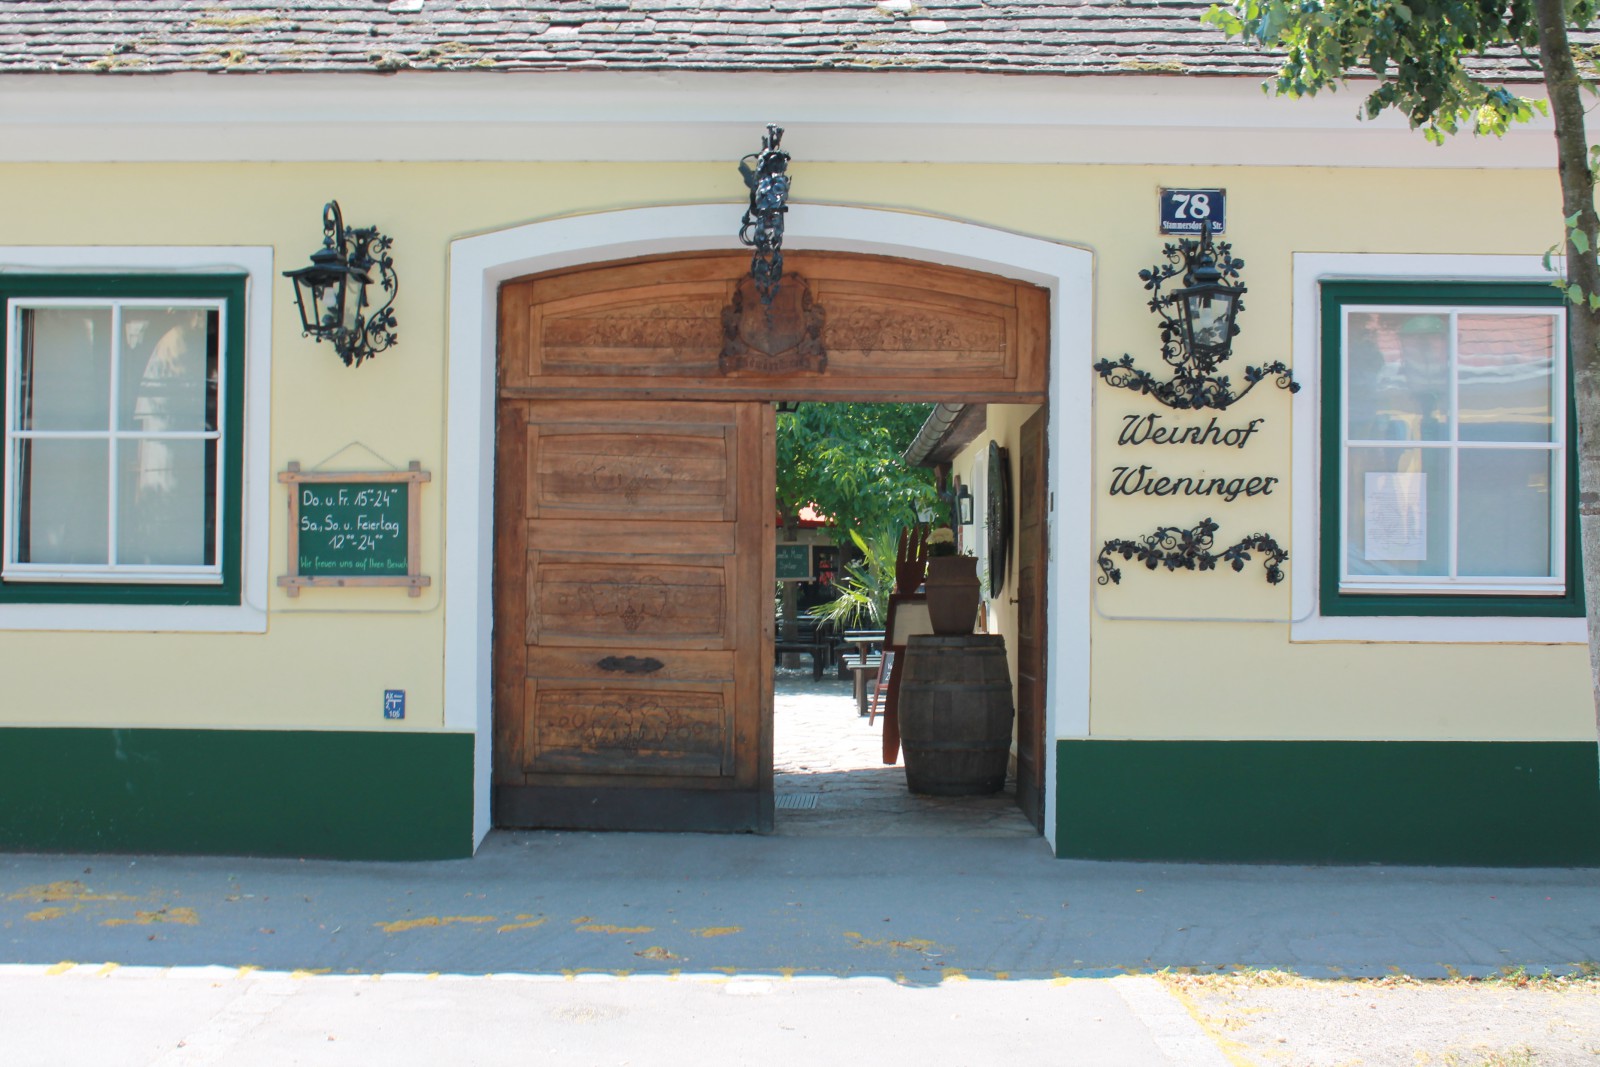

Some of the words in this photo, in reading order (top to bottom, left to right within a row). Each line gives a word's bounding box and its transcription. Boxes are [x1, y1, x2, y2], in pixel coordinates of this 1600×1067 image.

[1171, 193, 1210, 219] 78
[1117, 413, 1265, 449] Weinhof
[1109, 464, 1279, 502] Wieninger
[303, 489, 323, 506] Do.
[325, 497, 336, 506] u.
[338, 489, 350, 506] Fr.
[324, 514, 341, 531] So.
[343, 522, 353, 531] u.
[357, 513, 399, 538] Feiertag
[300, 556, 312, 569] Wir
[315, 556, 336, 570] freuen
[339, 561, 353, 569] uns
[355, 558, 368, 571] auf
